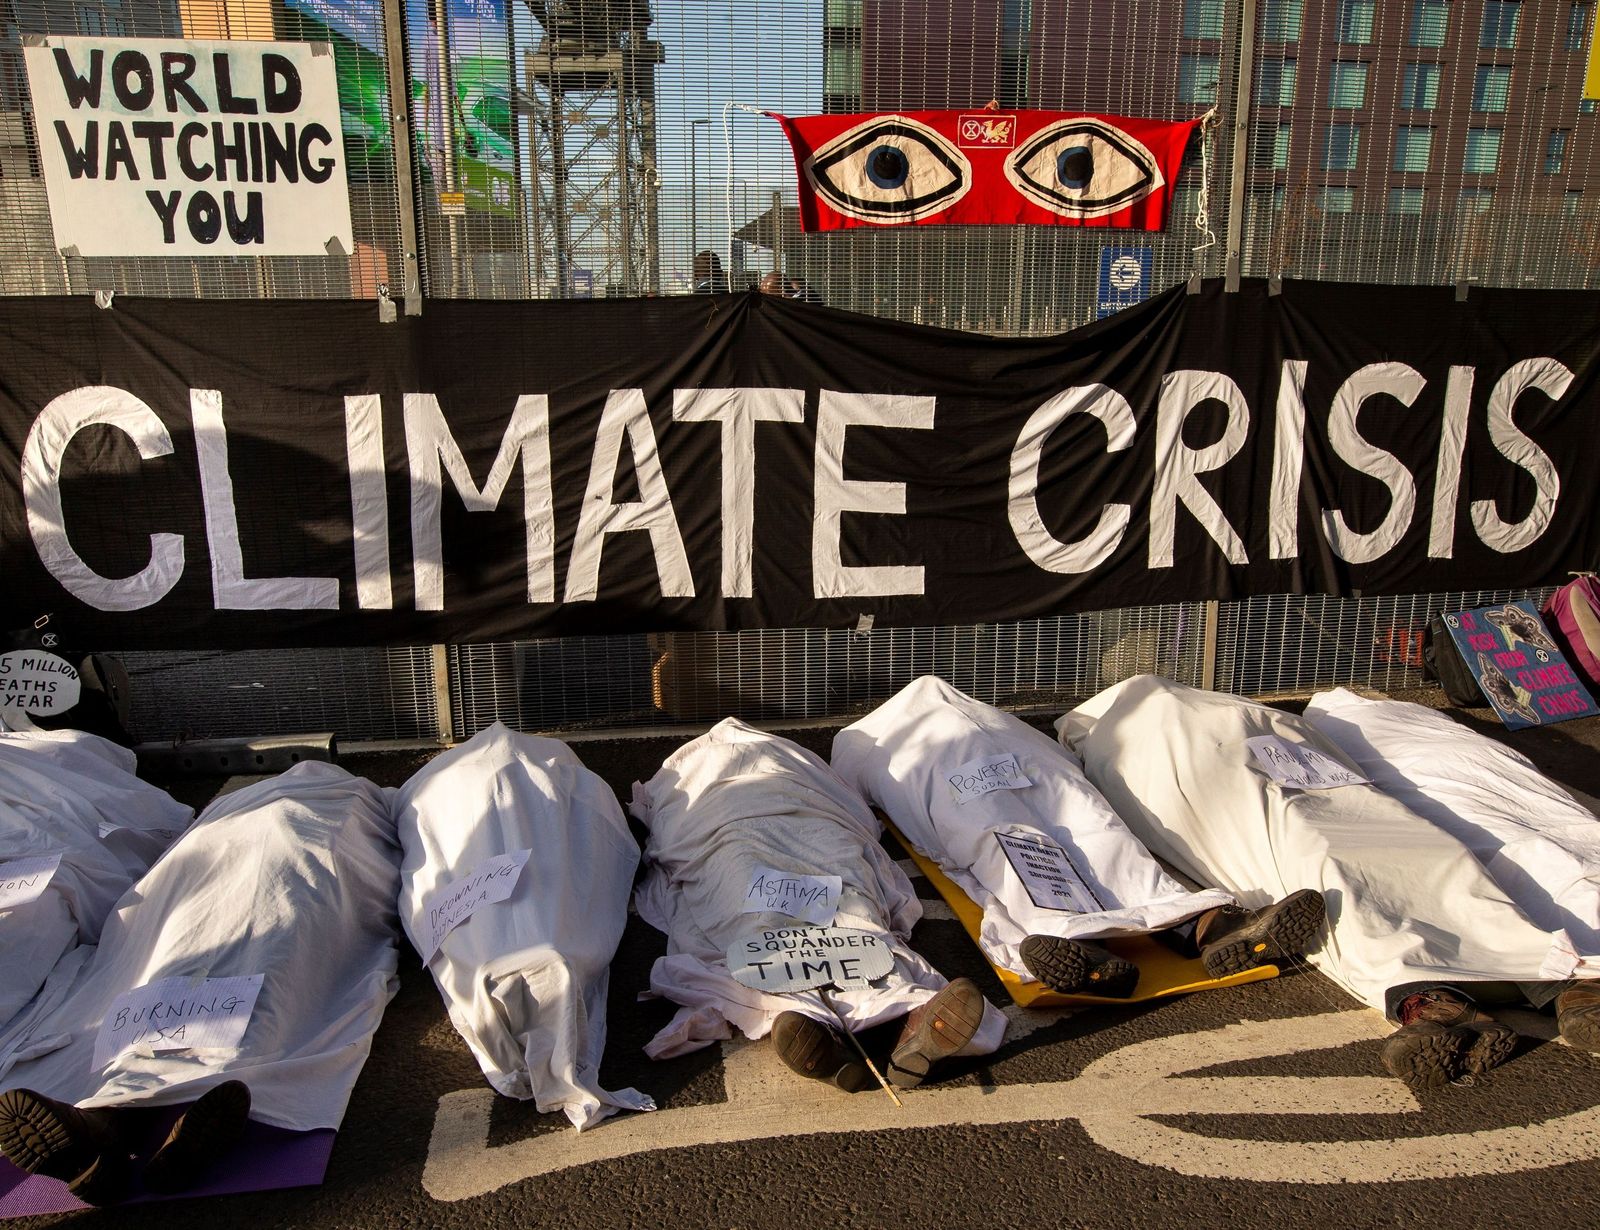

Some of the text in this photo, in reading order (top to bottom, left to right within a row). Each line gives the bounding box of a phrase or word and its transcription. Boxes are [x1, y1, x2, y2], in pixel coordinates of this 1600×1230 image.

[52, 48, 302, 115] WORLD
[54, 120, 336, 184] WATCHING
[146, 190, 265, 245] YOU
[21, 357, 1574, 611] CLIMATE CRISIS
[22, 658, 79, 680] MILLION
[1494, 651, 1529, 670] FROM
[0, 678, 58, 693] EATHS
[1517, 663, 1576, 690] CLIMATE
[4, 694, 53, 708] YEAR
[1538, 690, 1588, 716] CHAOS
[949, 760, 1019, 793] POVERTY
[972, 780, 1011, 795] SUDAN
[1005, 840, 1036, 852] CLIMATE
[1020, 852, 1057, 866] POLITICAL
[1026, 861, 1062, 874] INACTION
[430, 864, 519, 929] DROWNING
[748, 875, 829, 906] ASTHMA
[746, 935, 876, 952] SQUANDER
[763, 927, 828, 940] DON'T
[786, 949, 827, 958] THE
[747, 958, 861, 980] TIME
[112, 996, 245, 1031] BURNING
[131, 1024, 187, 1045] USA
